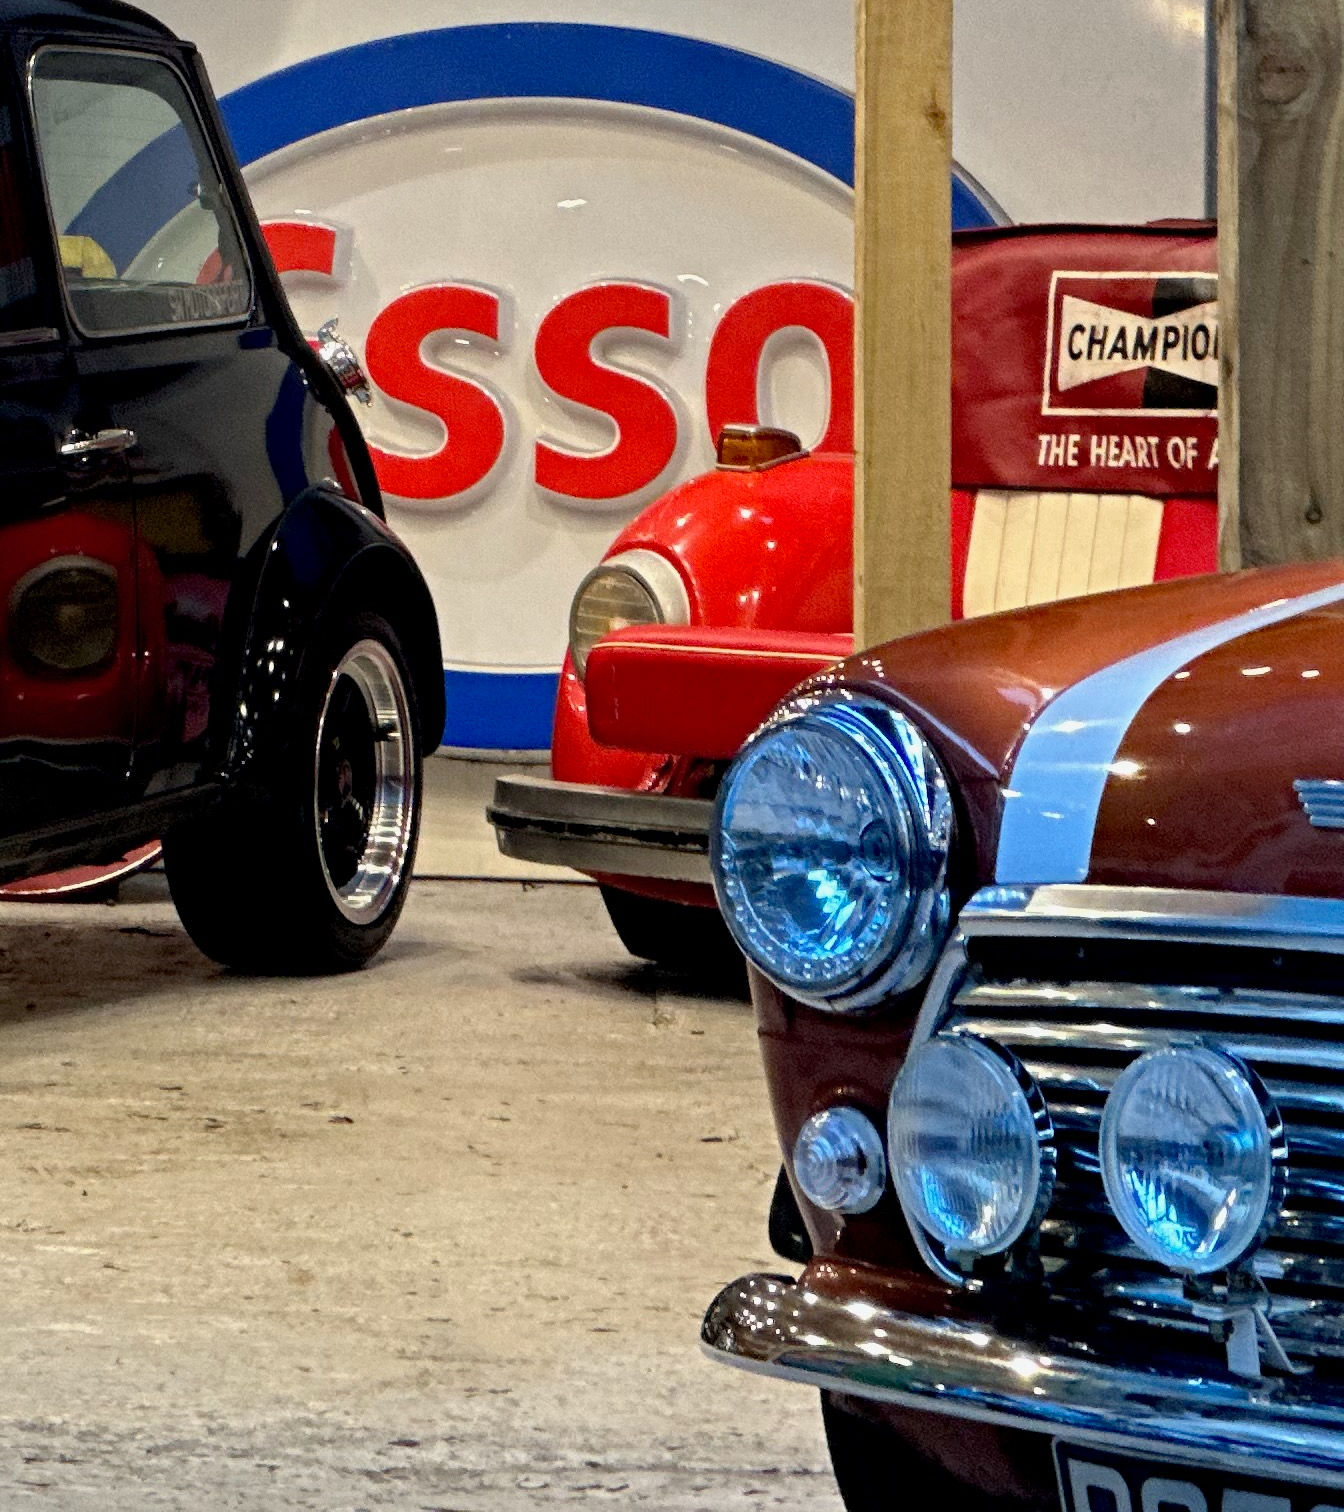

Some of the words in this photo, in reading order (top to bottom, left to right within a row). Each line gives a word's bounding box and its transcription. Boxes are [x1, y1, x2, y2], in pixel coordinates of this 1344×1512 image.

[1067, 323, 1219, 362] CHAMPIO
[1038, 434, 1080, 467] THE
[1090, 434, 1159, 469] HEART
[1167, 436, 1198, 470] OF
